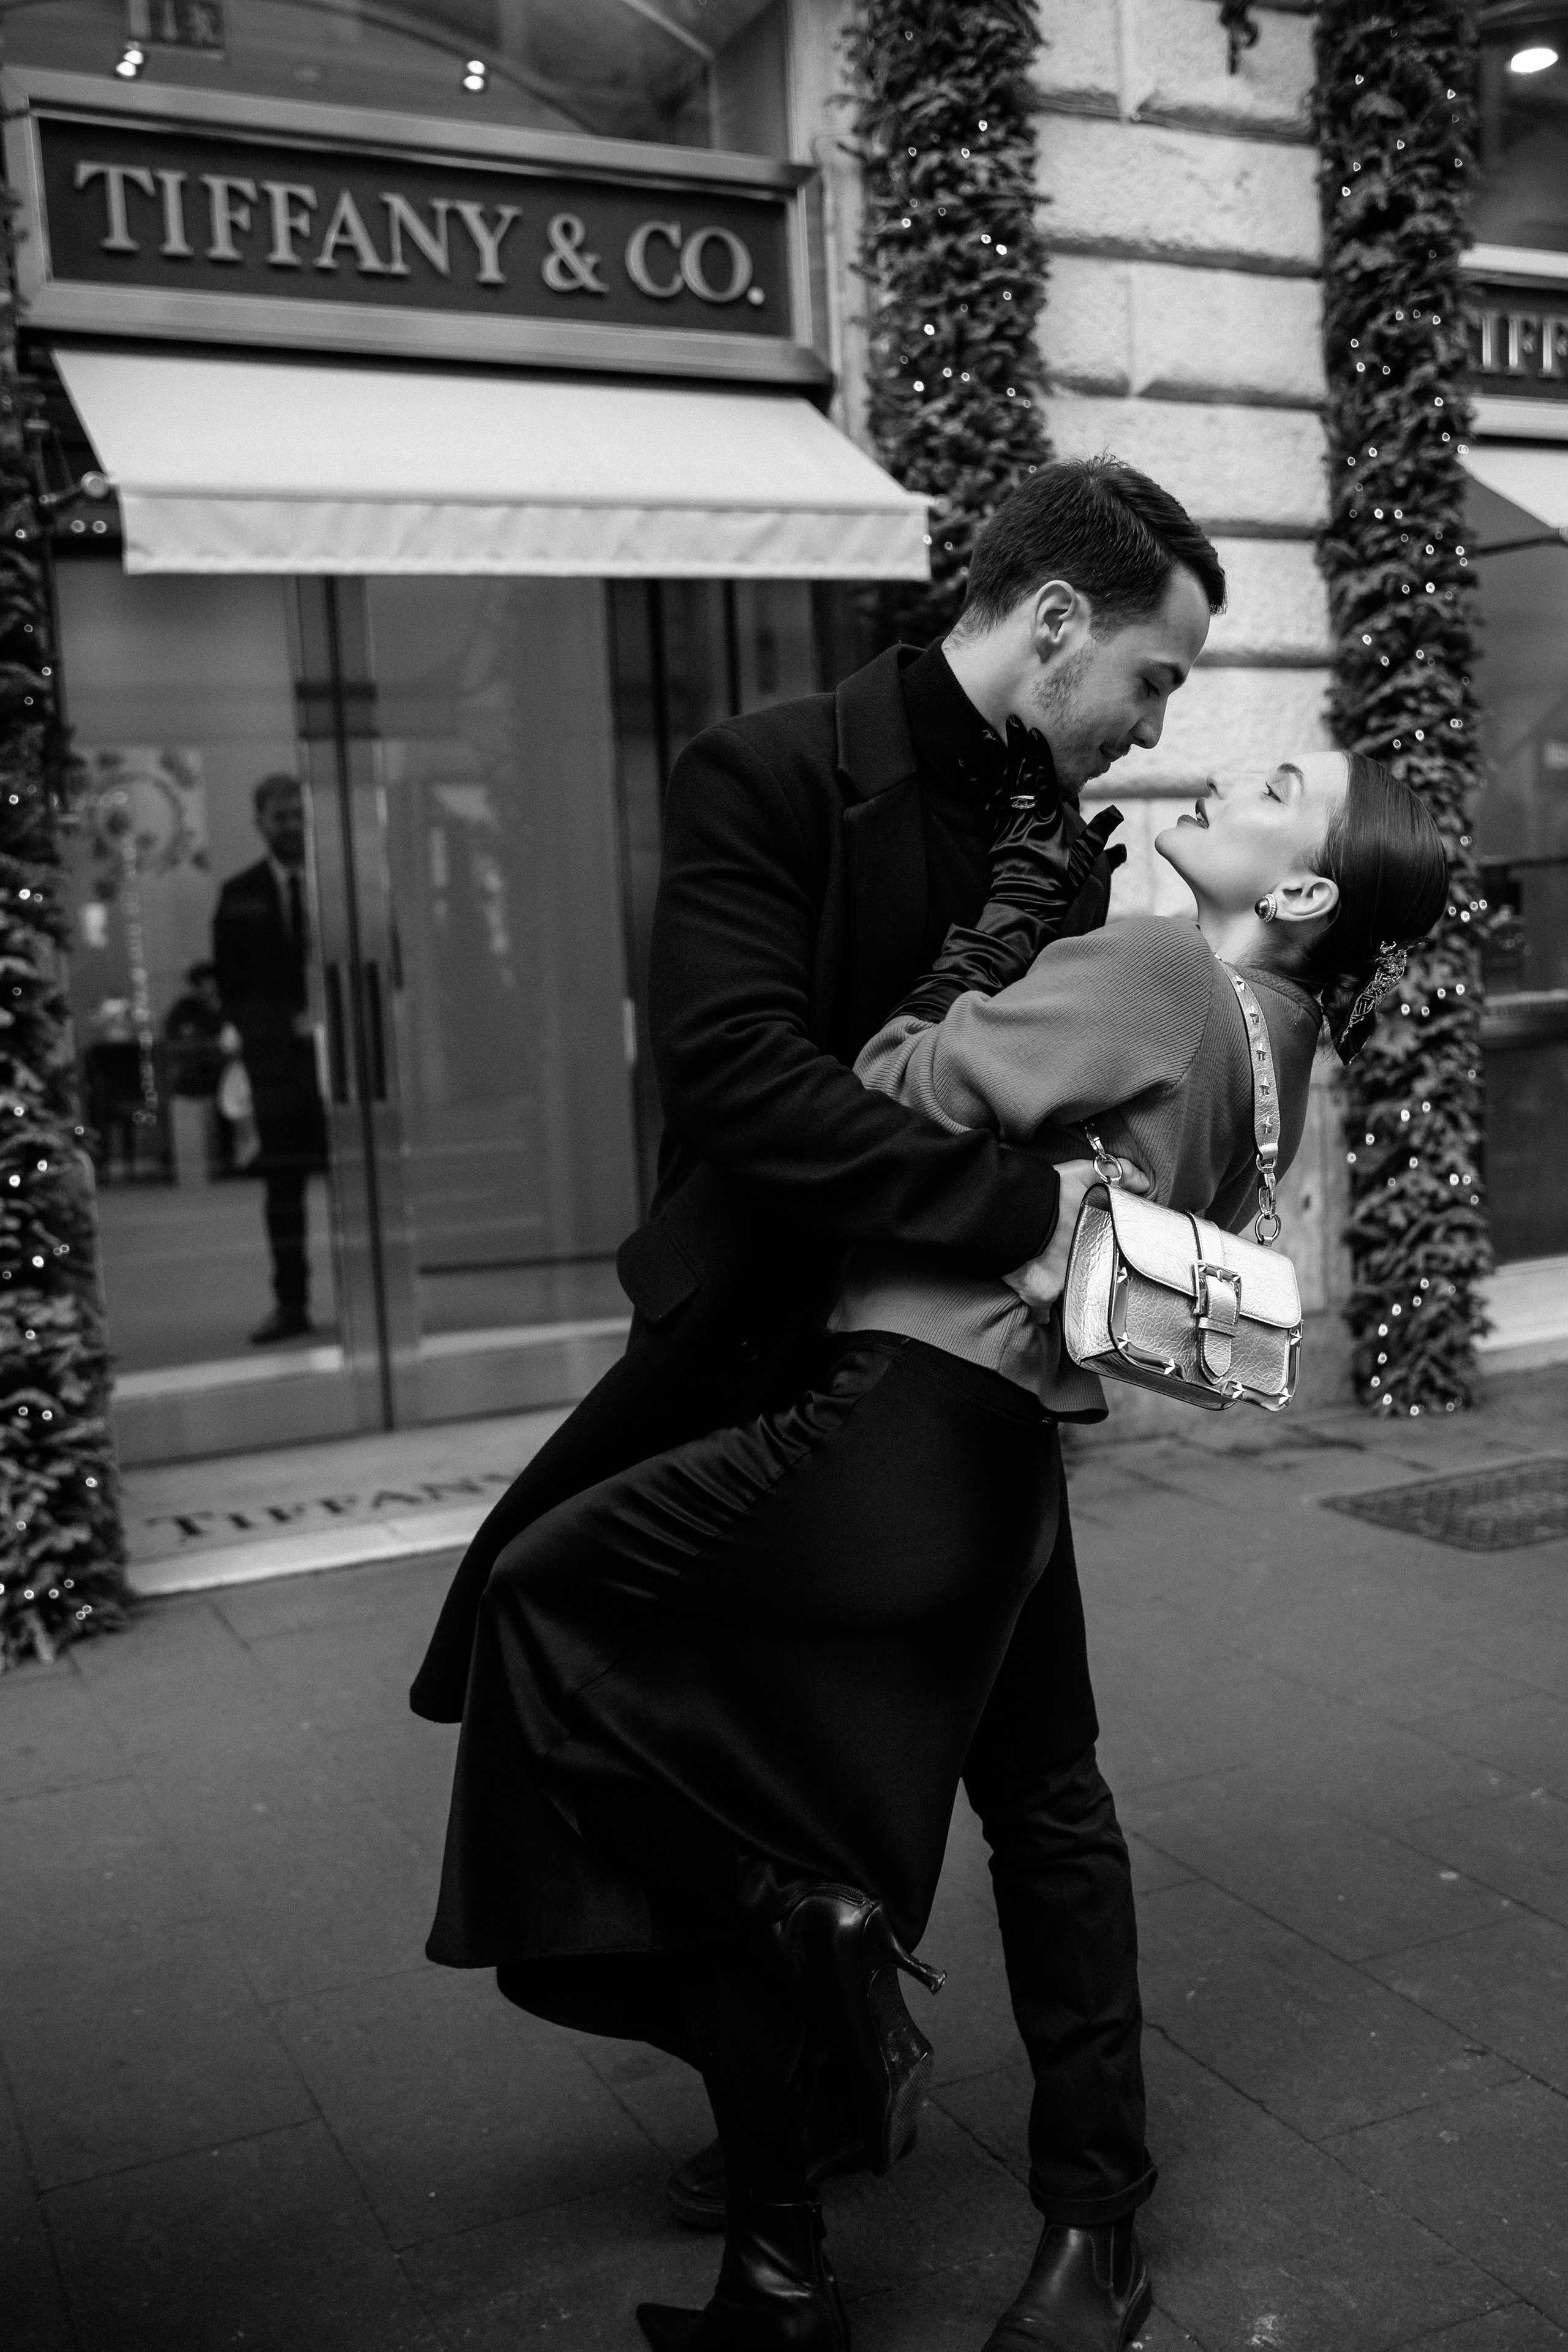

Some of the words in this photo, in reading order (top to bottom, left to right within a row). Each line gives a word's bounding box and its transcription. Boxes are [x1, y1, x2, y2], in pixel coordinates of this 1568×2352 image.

[75, 160, 521, 284] TIFFANY
[541, 212, 609, 293] &
[624, 221, 766, 304] CO.
[1464, 307, 1568, 378] IFF
